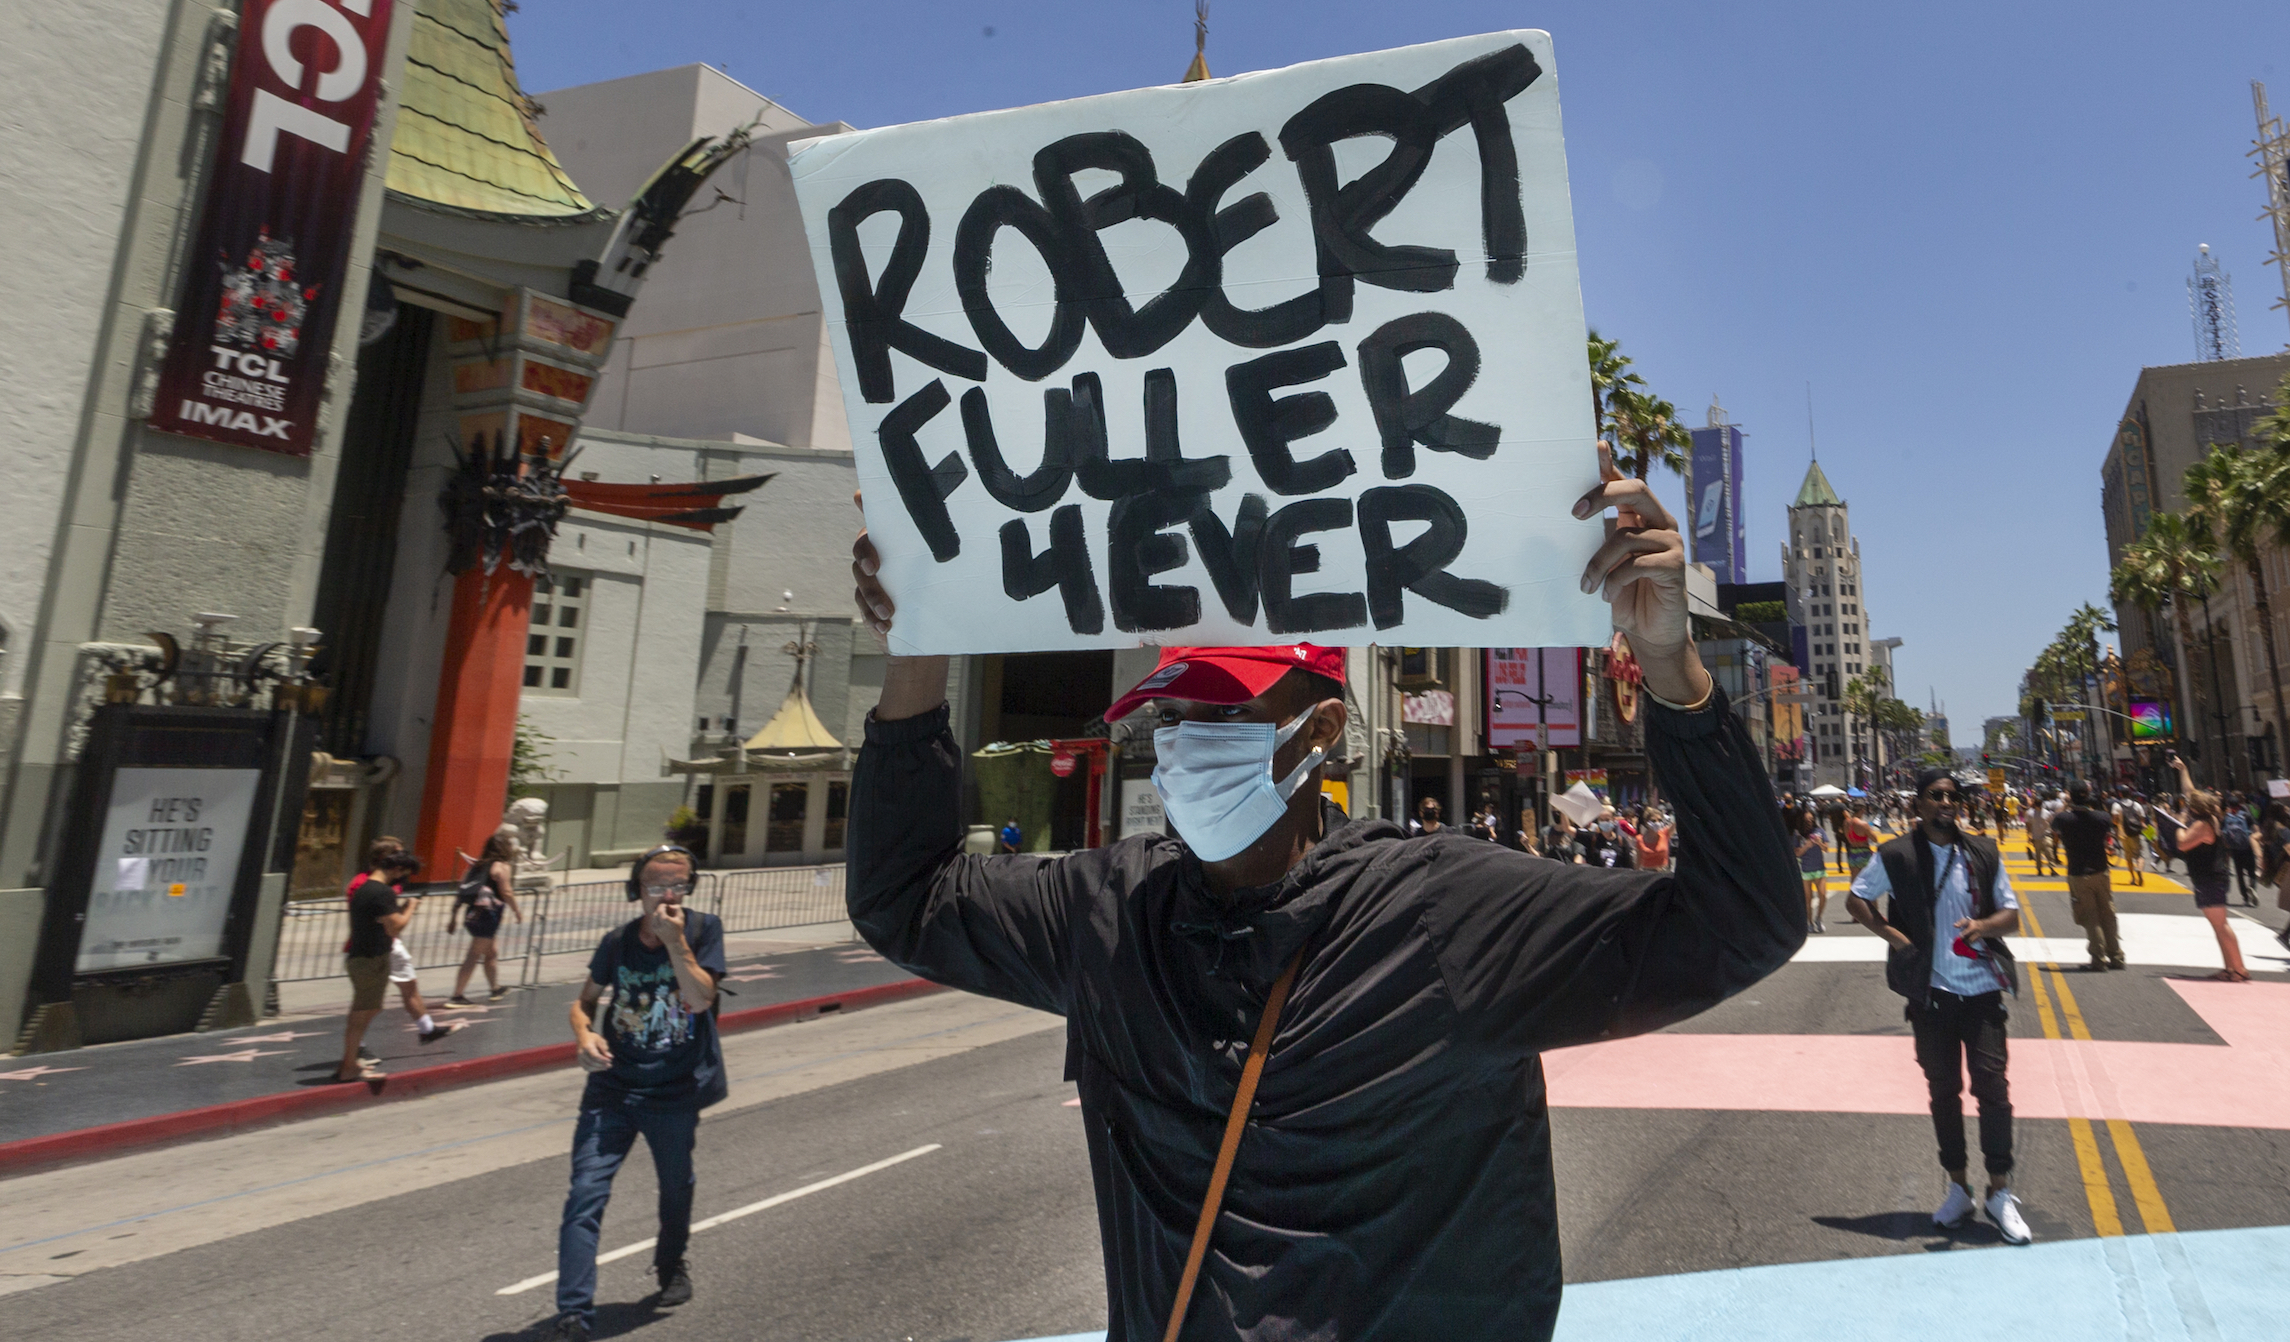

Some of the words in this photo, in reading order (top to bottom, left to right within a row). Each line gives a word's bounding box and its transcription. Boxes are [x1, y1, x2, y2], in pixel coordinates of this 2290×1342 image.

[240, 0, 373, 174] CL
[828, 43, 1543, 404] ROBERT
[210, 345, 290, 384] TCL
[201, 383, 285, 412] THEATRES
[203, 371, 287, 400] CHINESE
[178, 399, 296, 440] IMAX
[877, 310, 1502, 563] FULLER
[999, 484, 1510, 636] 4EVER
[149, 797, 202, 823] HE'S
[123, 827, 214, 854] SITTING
[150, 857, 208, 883] YOUR
